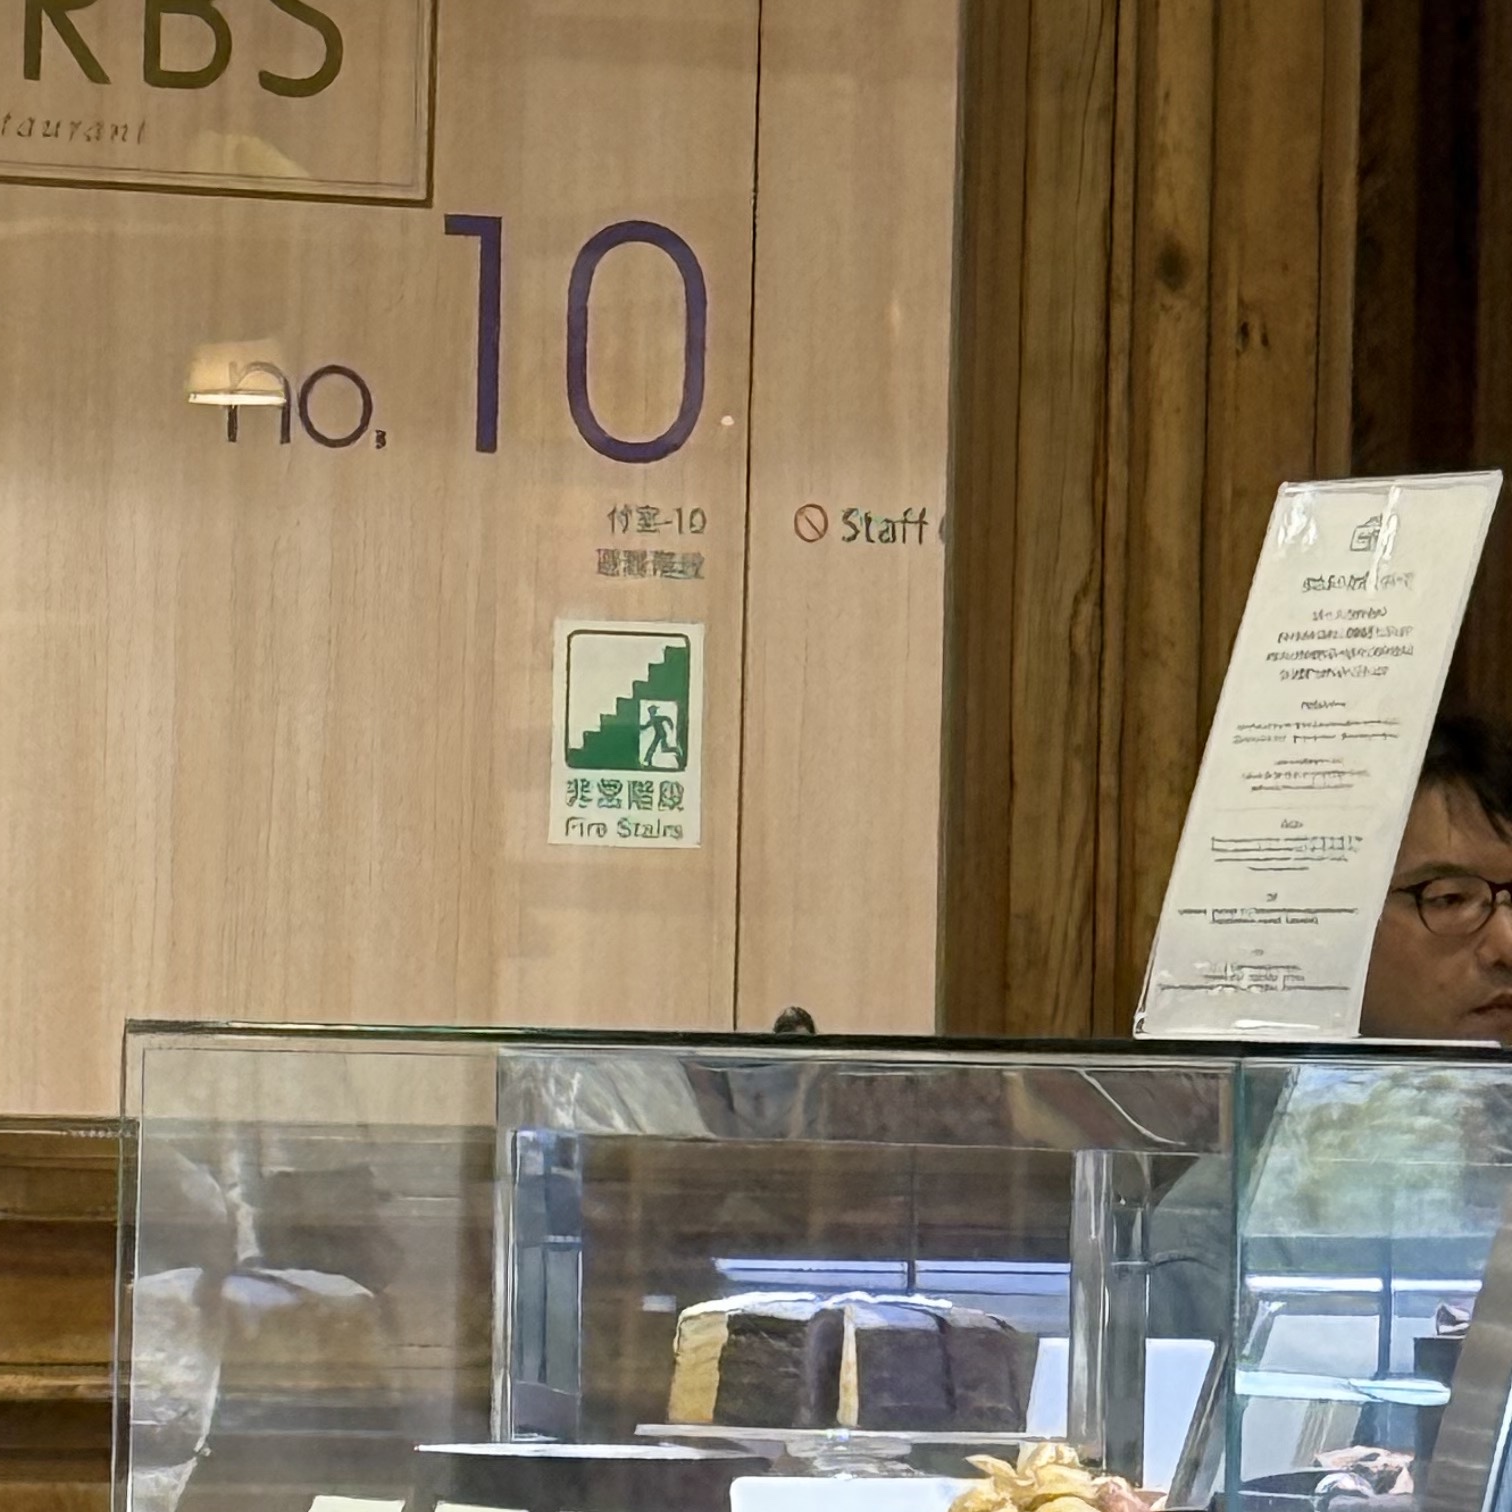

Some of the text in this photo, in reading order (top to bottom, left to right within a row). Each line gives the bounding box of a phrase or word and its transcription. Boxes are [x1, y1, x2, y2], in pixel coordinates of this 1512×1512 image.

[226, 213, 708, 464] no. 10
[841, 507, 929, 545] Staff
[565, 816, 684, 840] Fire Stairs
